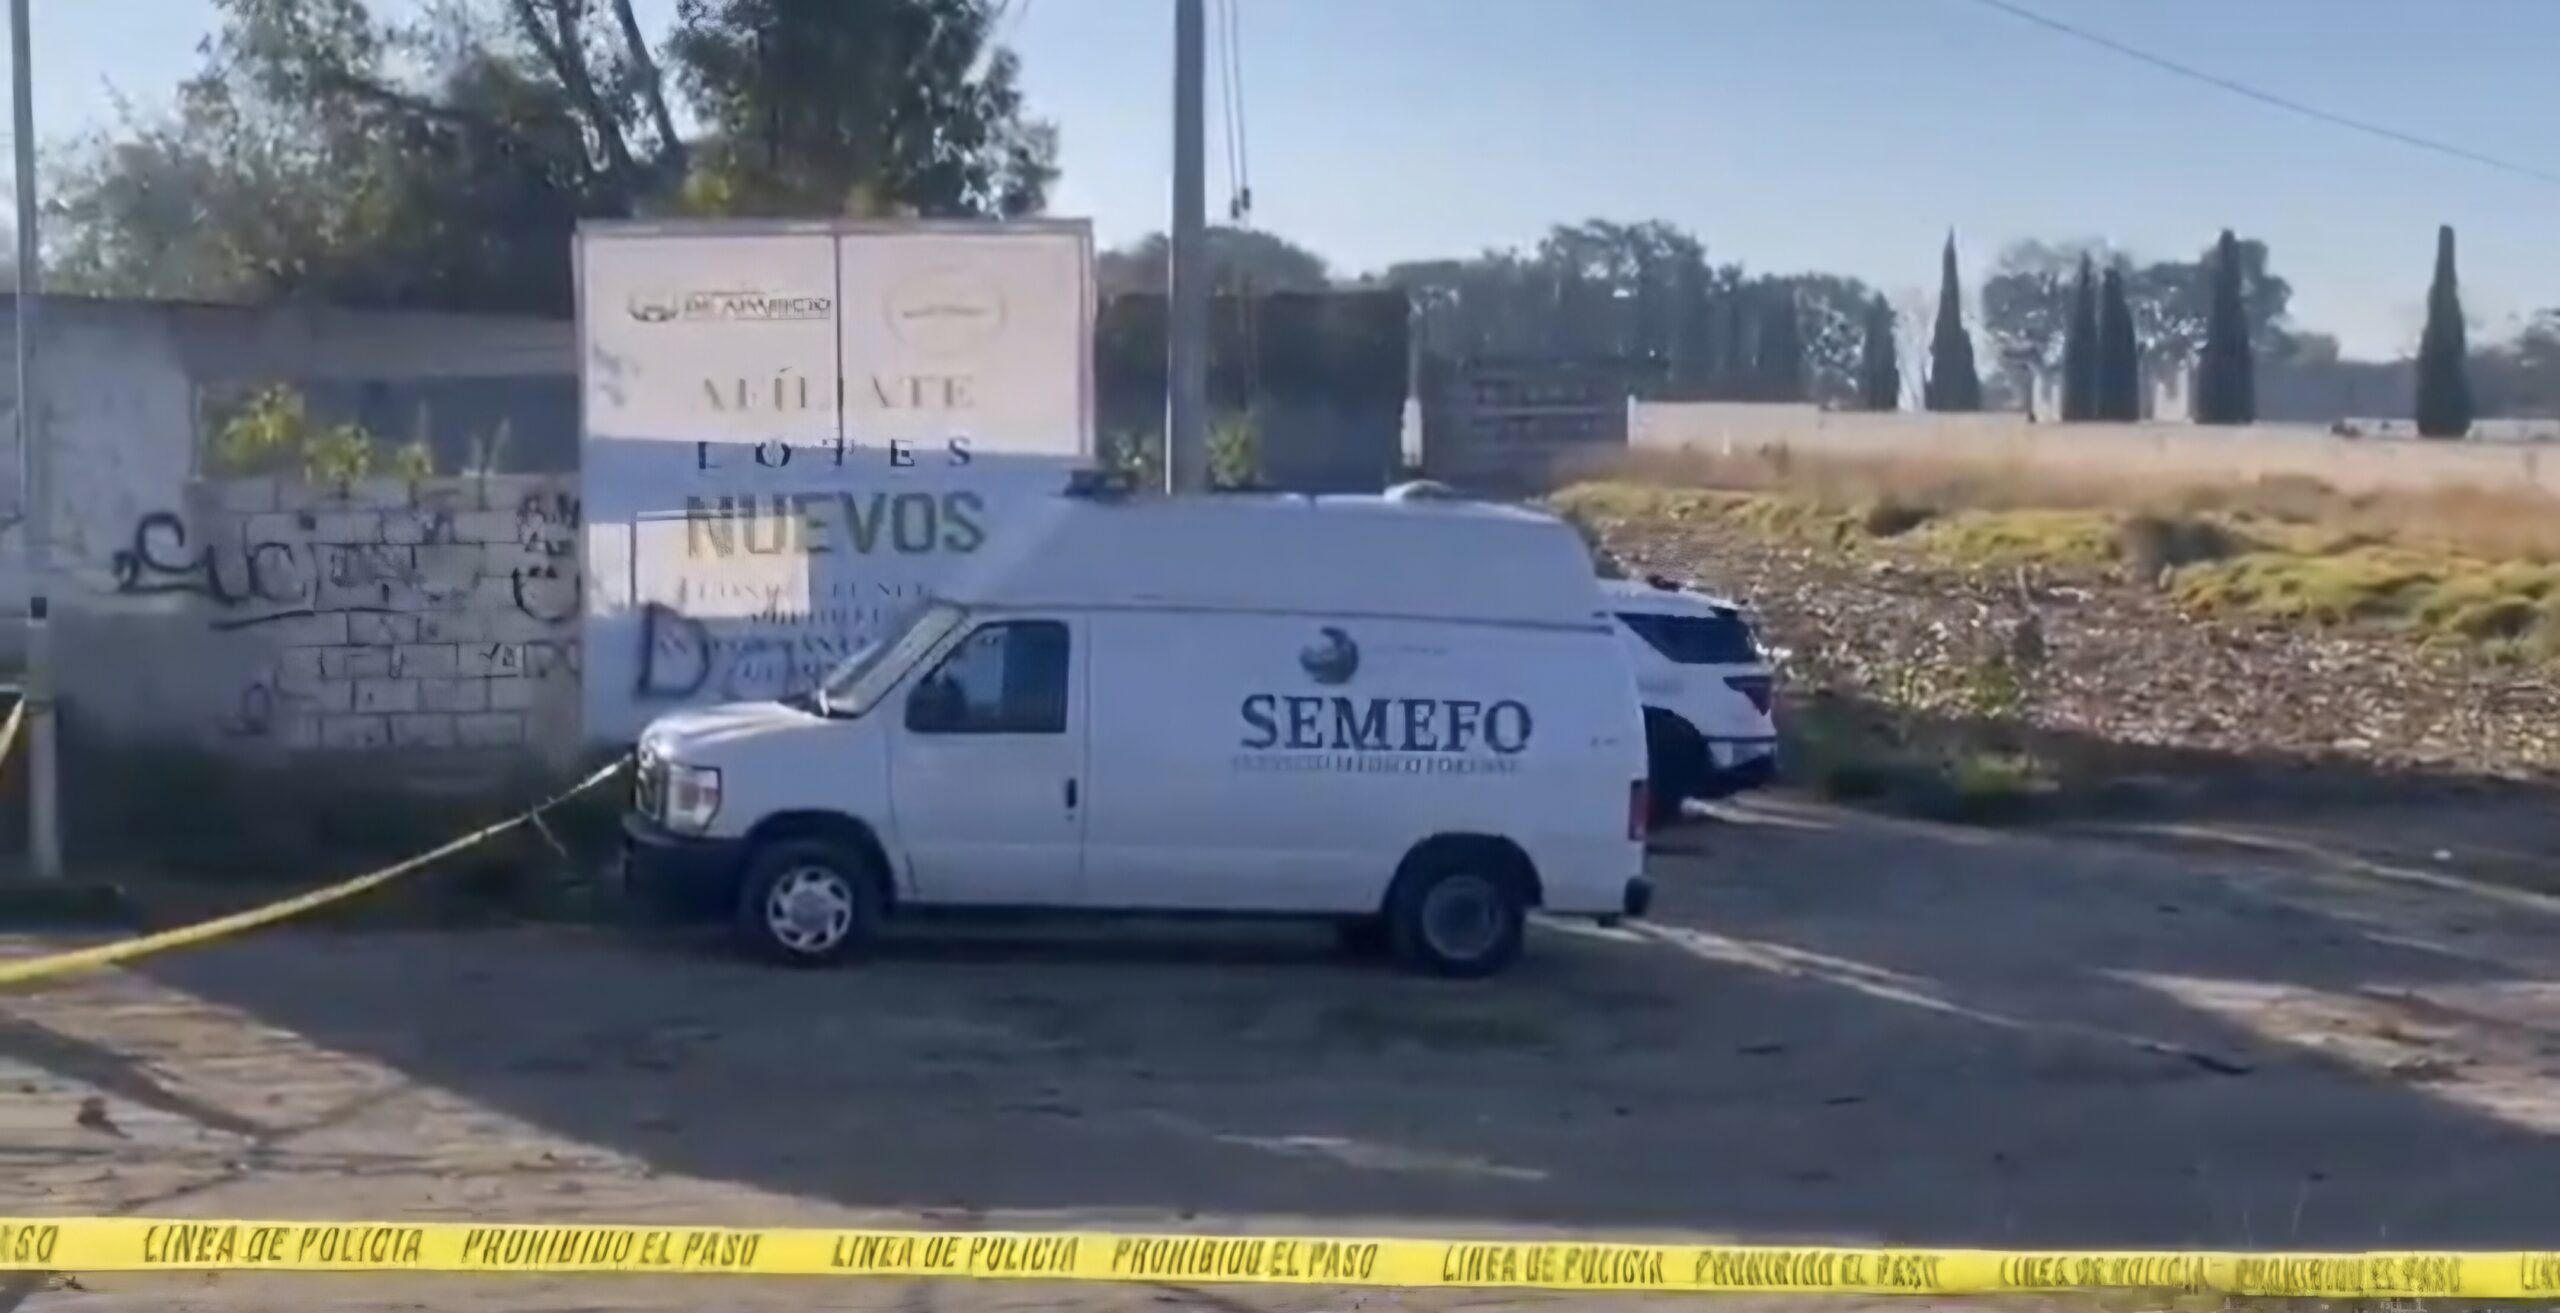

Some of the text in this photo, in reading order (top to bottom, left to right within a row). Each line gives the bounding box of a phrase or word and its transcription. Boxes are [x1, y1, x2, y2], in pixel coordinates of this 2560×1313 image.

[697, 437, 972, 469] LOTES
[687, 491, 986, 557] NUEVOS
[1240, 694, 1534, 754] SEMEFO
[144, 1225, 424, 1263] LINEA DE POLICIA
[461, 1229, 762, 1267] PROHIBIDO EL PASO
[831, 1235, 1081, 1272] LINEA DE POLICIA
[1112, 1239, 1378, 1279] PROHIBIDO EL PASO
